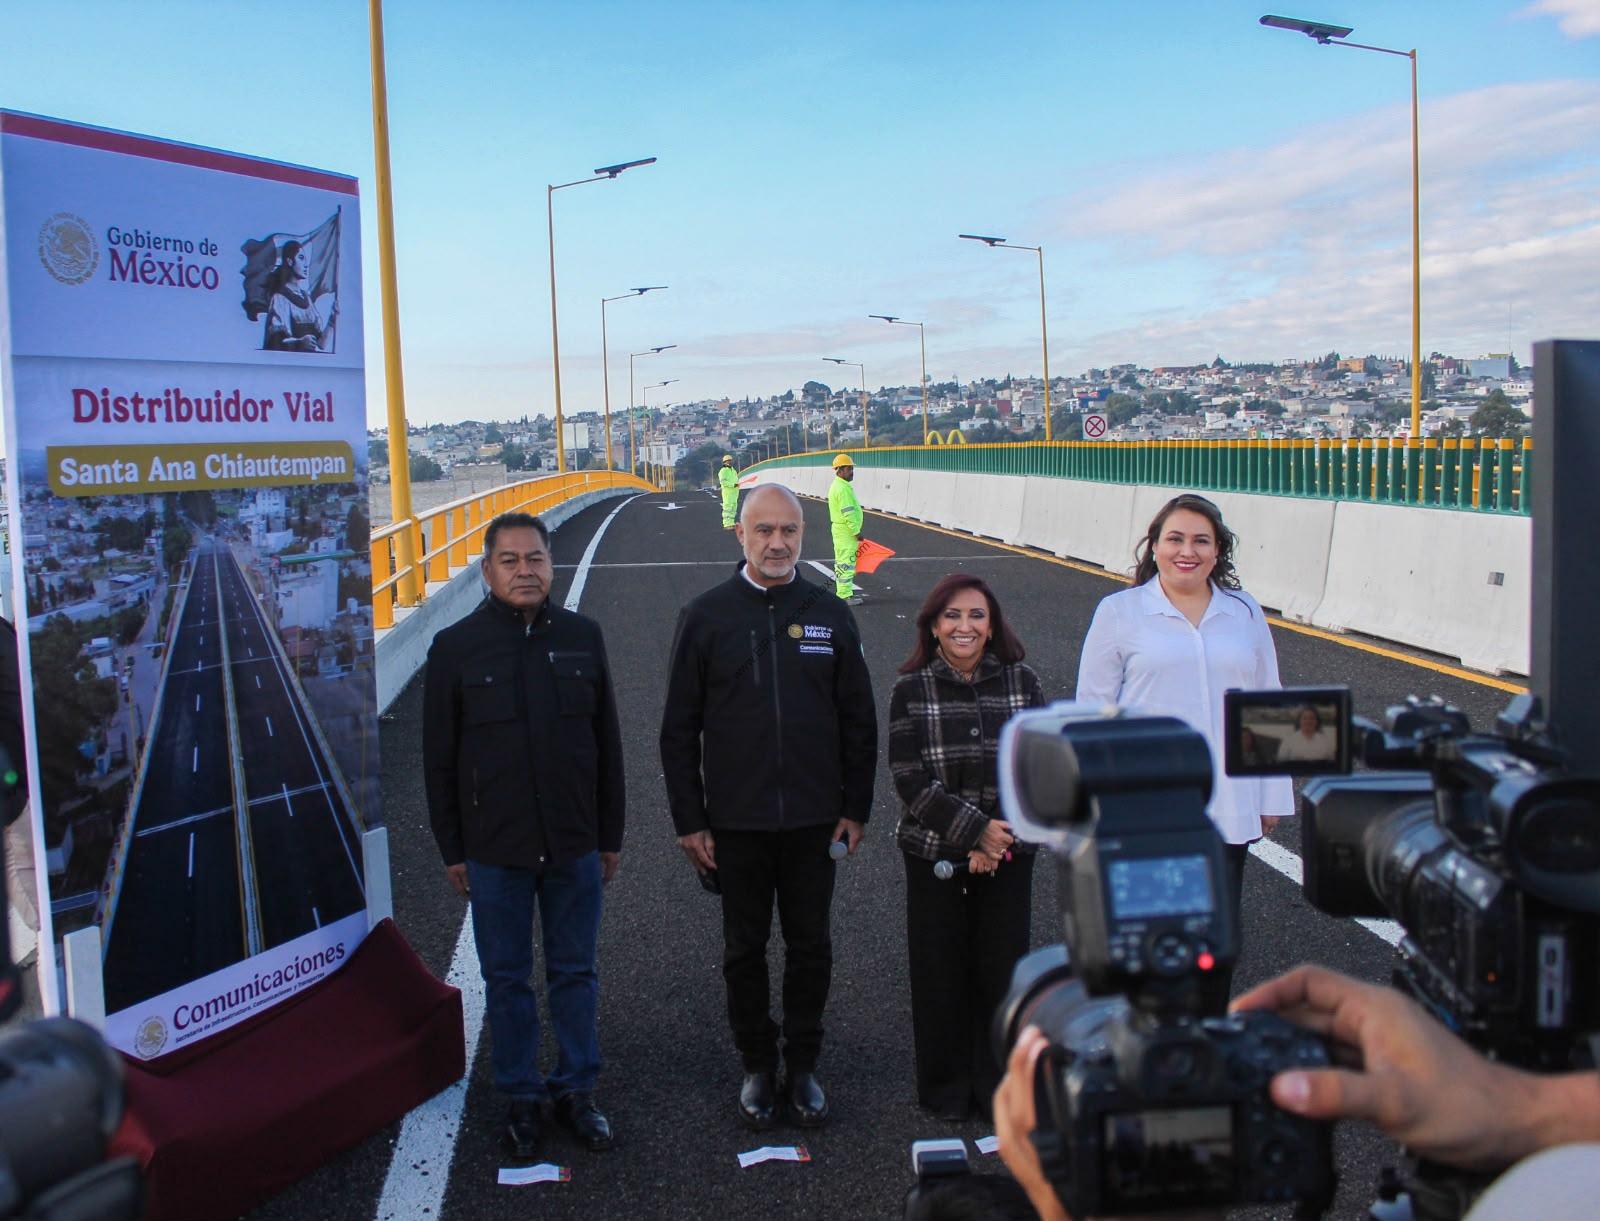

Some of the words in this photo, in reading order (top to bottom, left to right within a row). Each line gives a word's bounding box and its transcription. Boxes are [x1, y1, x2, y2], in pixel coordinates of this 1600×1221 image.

[107, 226, 195, 255] Gobierno
[199, 238, 219, 257] de
[108, 248, 219, 291] México
[71, 387, 274, 424] Distribuidor
[283, 391, 335, 423] Vial
[58, 457, 139, 486] Santa
[148, 455, 197, 482] Ana
[204, 453, 346, 481] Chiautempan
[805, 629, 831, 638] México
[172, 941, 346, 1031] Comunicaciones
